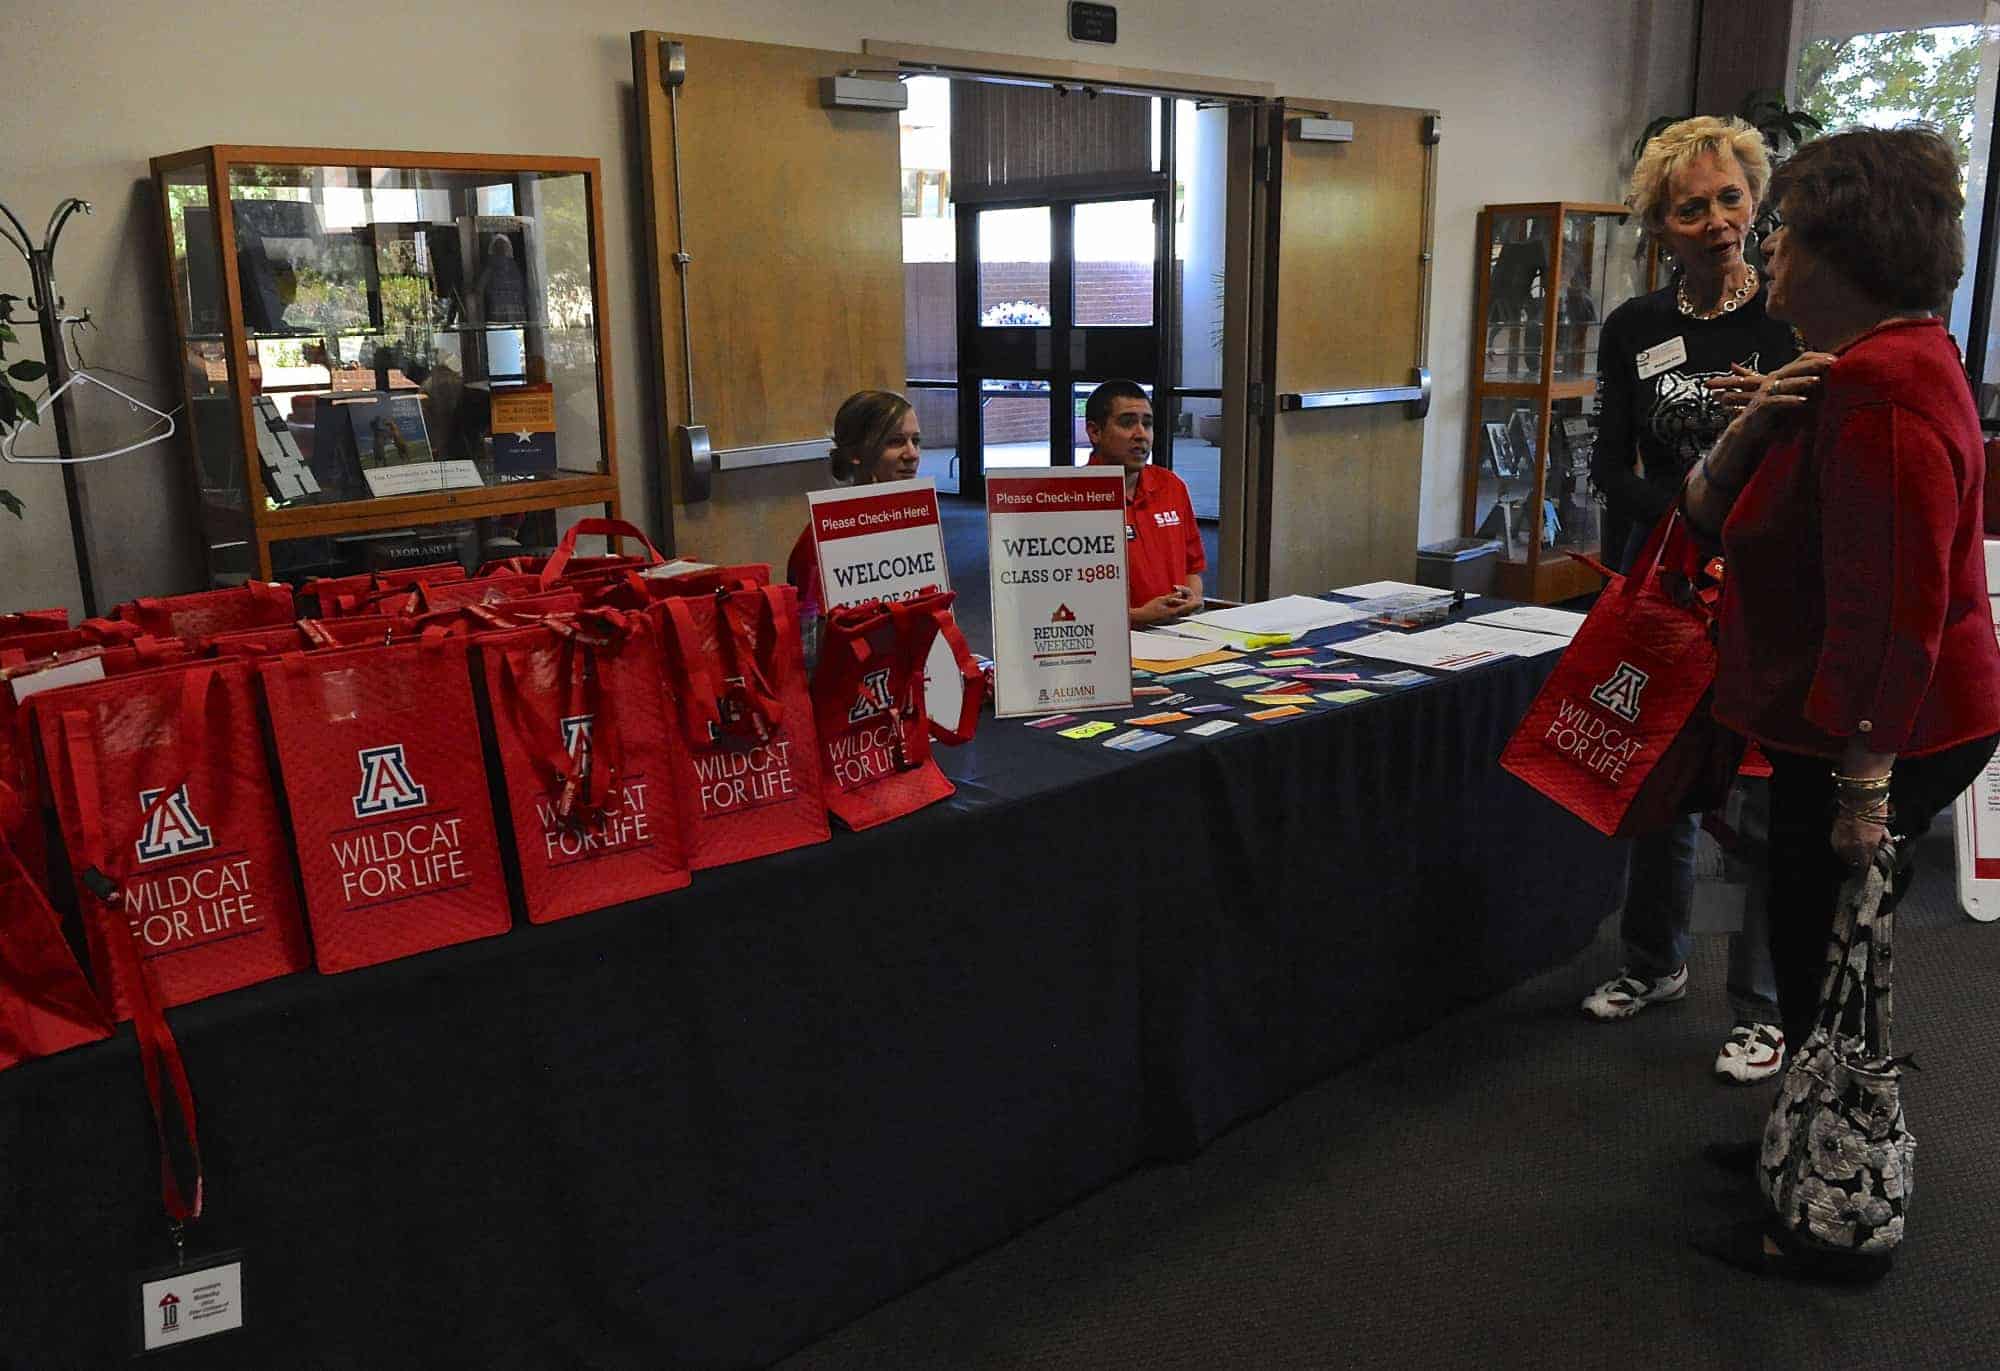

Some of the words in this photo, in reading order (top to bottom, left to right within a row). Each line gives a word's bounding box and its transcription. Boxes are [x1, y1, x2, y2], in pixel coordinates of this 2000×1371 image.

[996, 492, 1033, 505] Please
[1035, 491, 1084, 504] Check-in
[1087, 490, 1116, 502] Here!
[822, 516, 856, 531] Please
[857, 510, 902, 526] Check-in
[903, 505, 930, 519] Here!
[1002, 535, 1116, 558] WELCOME
[833, 552, 936, 588] WELCOME
[1000, 569, 1049, 585] CLASS
[1053, 568, 1073, 582] OF
[1077, 564, 1120, 583] 1988!
[1033, 624, 1095, 640] REUNION
[1034, 638, 1095, 652] WEEKEND
[1054, 685, 1096, 698] ALUMNI
[1558, 698, 1643, 763] WILDCAT
[692, 741, 791, 784] WILDCAT
[1545, 720, 1590, 760] FOR
[1587, 746, 1628, 783] LIFE
[833, 755, 875, 787] FOR
[701, 779, 748, 812] FOR
[752, 769, 793, 800] LIFE
[331, 818, 463, 869] WILDCAT
[601, 813, 649, 848] LIFE
[342, 863, 407, 902] FOR
[411, 850, 465, 887] LIFE
[198, 894, 258, 935] LIFE
